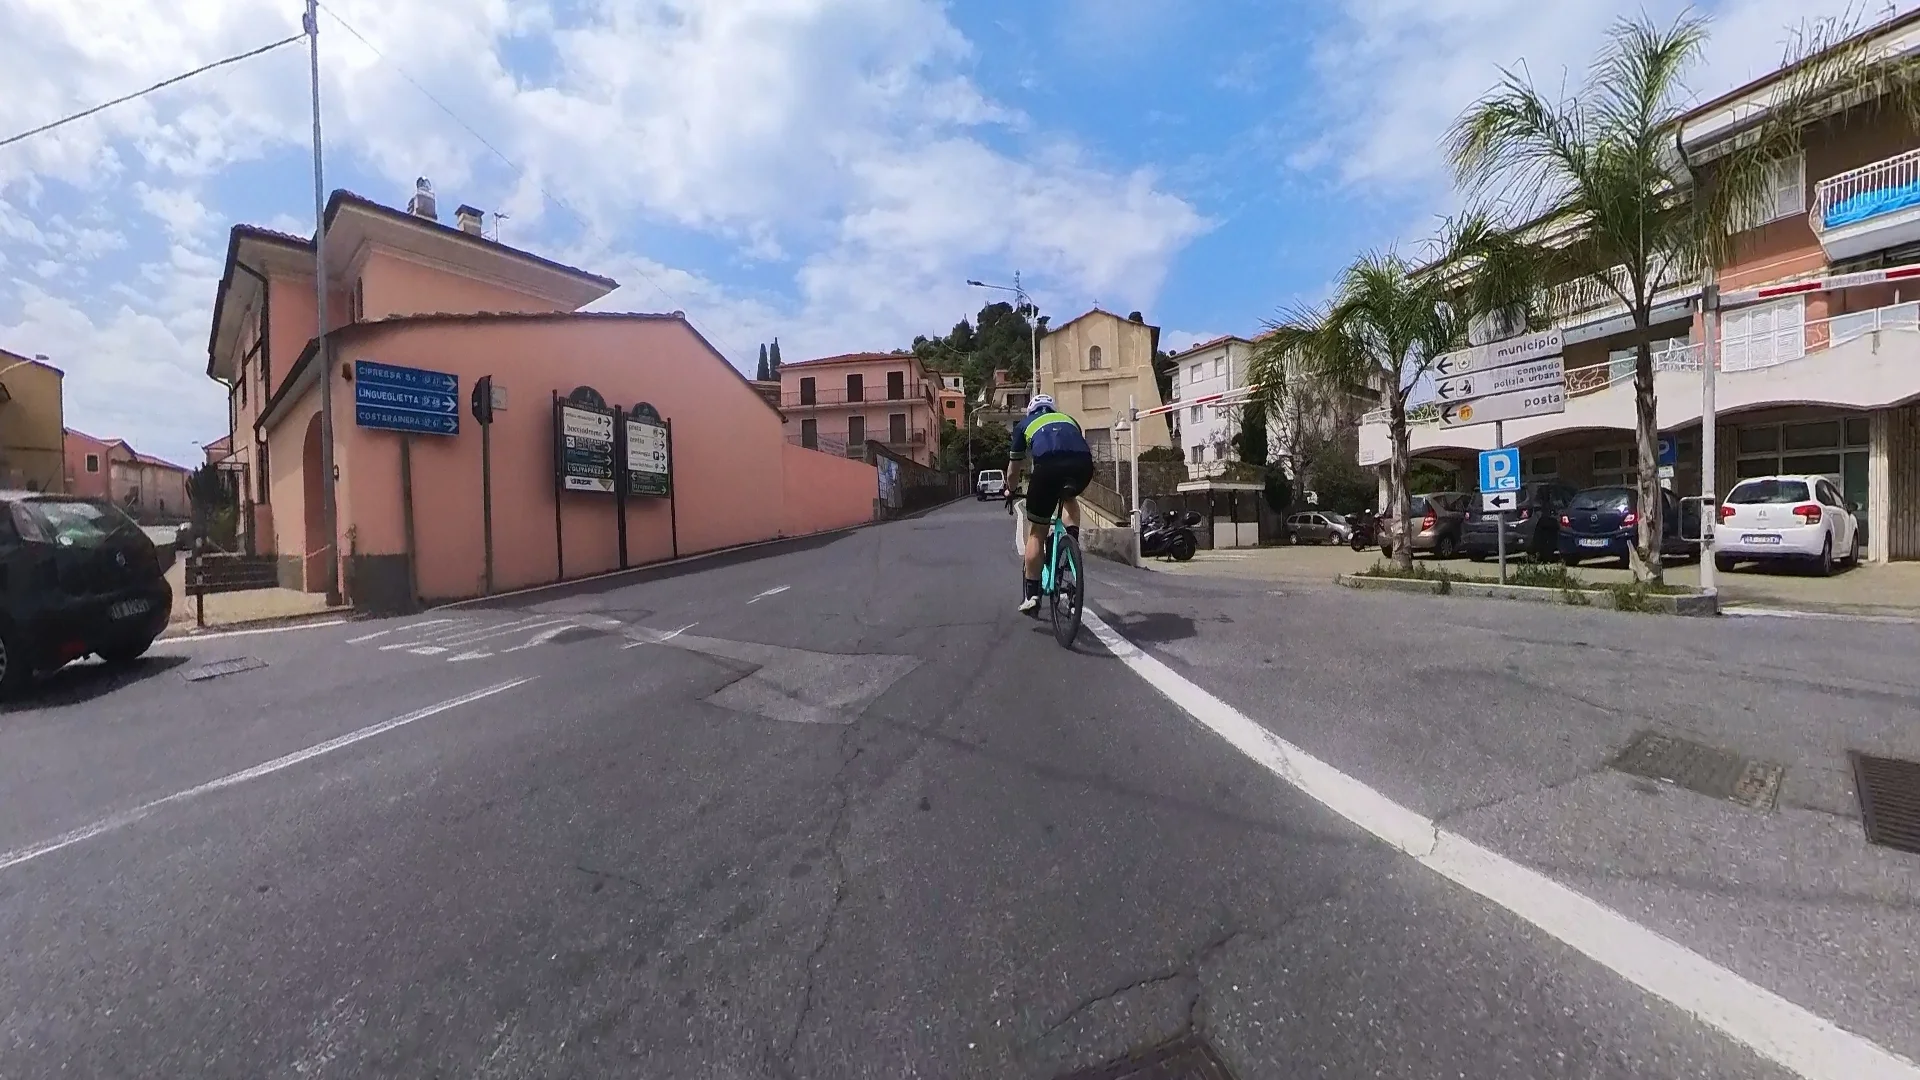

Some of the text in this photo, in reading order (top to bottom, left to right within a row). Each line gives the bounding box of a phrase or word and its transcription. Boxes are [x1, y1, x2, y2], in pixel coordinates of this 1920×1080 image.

[1497, 336, 1558, 358] municipio
[359, 366, 401, 380] CIPRESSA
[1517, 361, 1560, 376] comando
[1493, 376, 1524, 390] polizia
[358, 388, 419, 404] LINGUEGLIETTA
[1524, 394, 1560, 409] posta
[359, 411, 420, 425] COSTARAINERA
[1488, 453, 1511, 489] P
